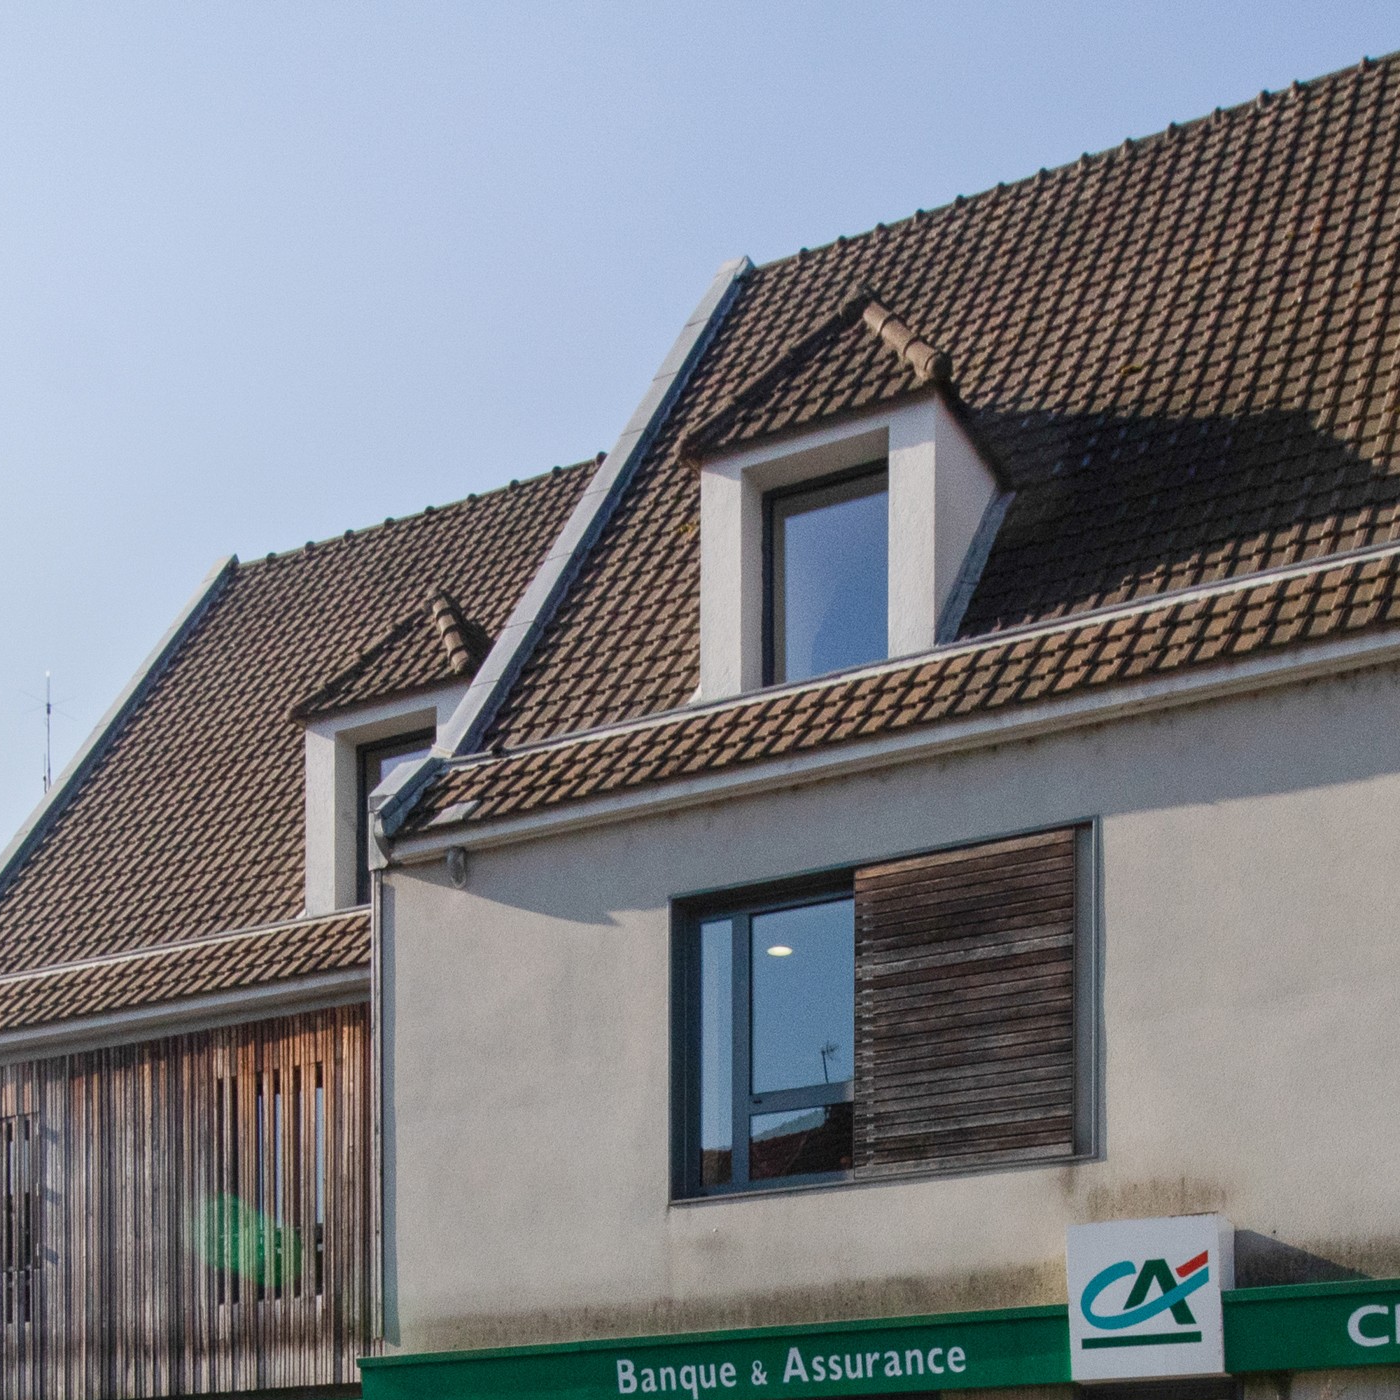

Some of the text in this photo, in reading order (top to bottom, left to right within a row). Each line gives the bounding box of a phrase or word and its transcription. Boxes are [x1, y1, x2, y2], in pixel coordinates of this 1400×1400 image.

[615, 1345, 966, 1400] Banque & Assurance
